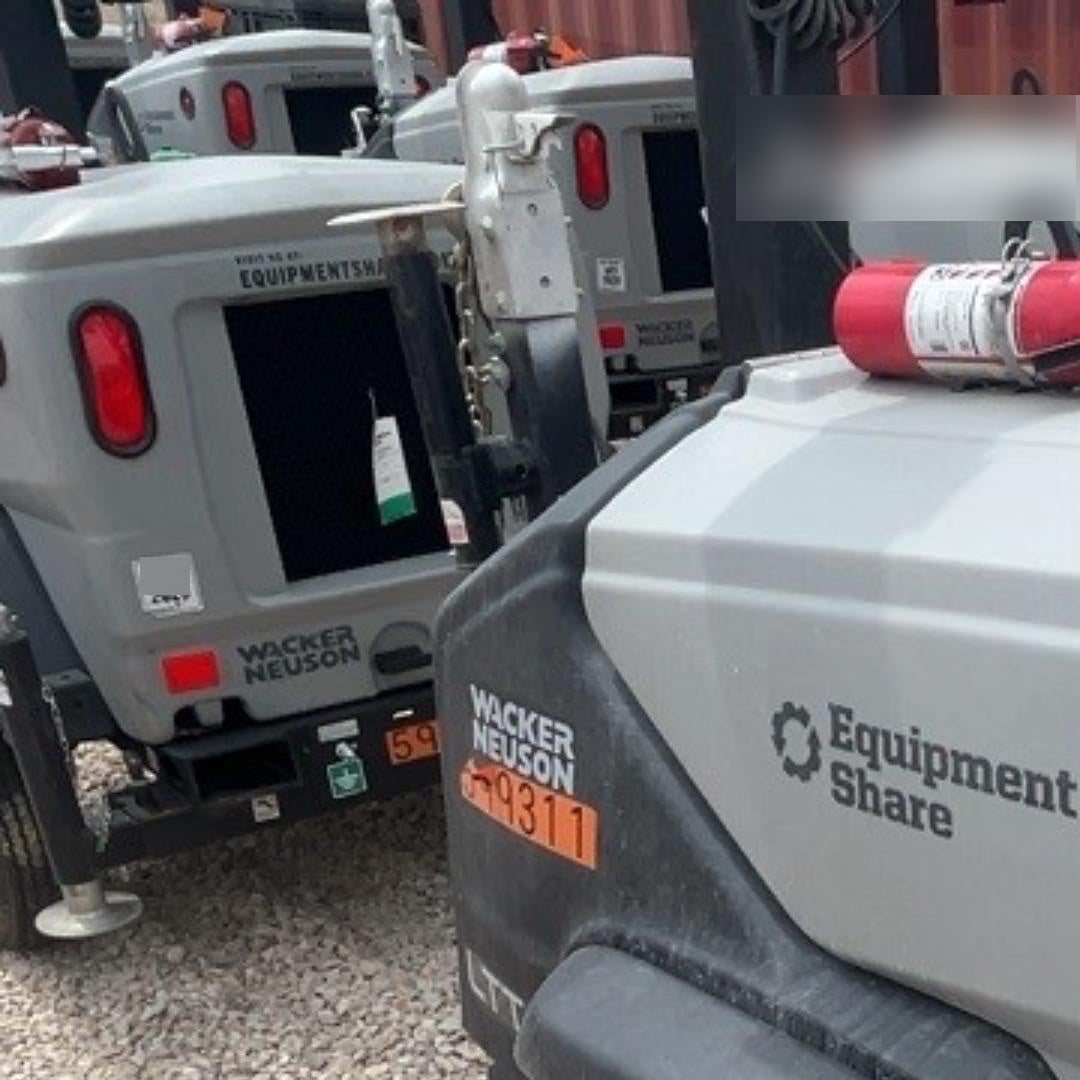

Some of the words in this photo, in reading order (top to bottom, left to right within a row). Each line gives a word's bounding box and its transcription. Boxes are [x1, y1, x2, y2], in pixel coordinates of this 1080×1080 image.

[237, 625, 357, 664] WACKER
[243, 645, 361, 685] NEUSON
[470, 684, 575, 760] WACKER
[473, 719, 574, 796] NEUSON
[827, 701, 1078, 820] Equipment
[830, 760, 953, 839] Share
